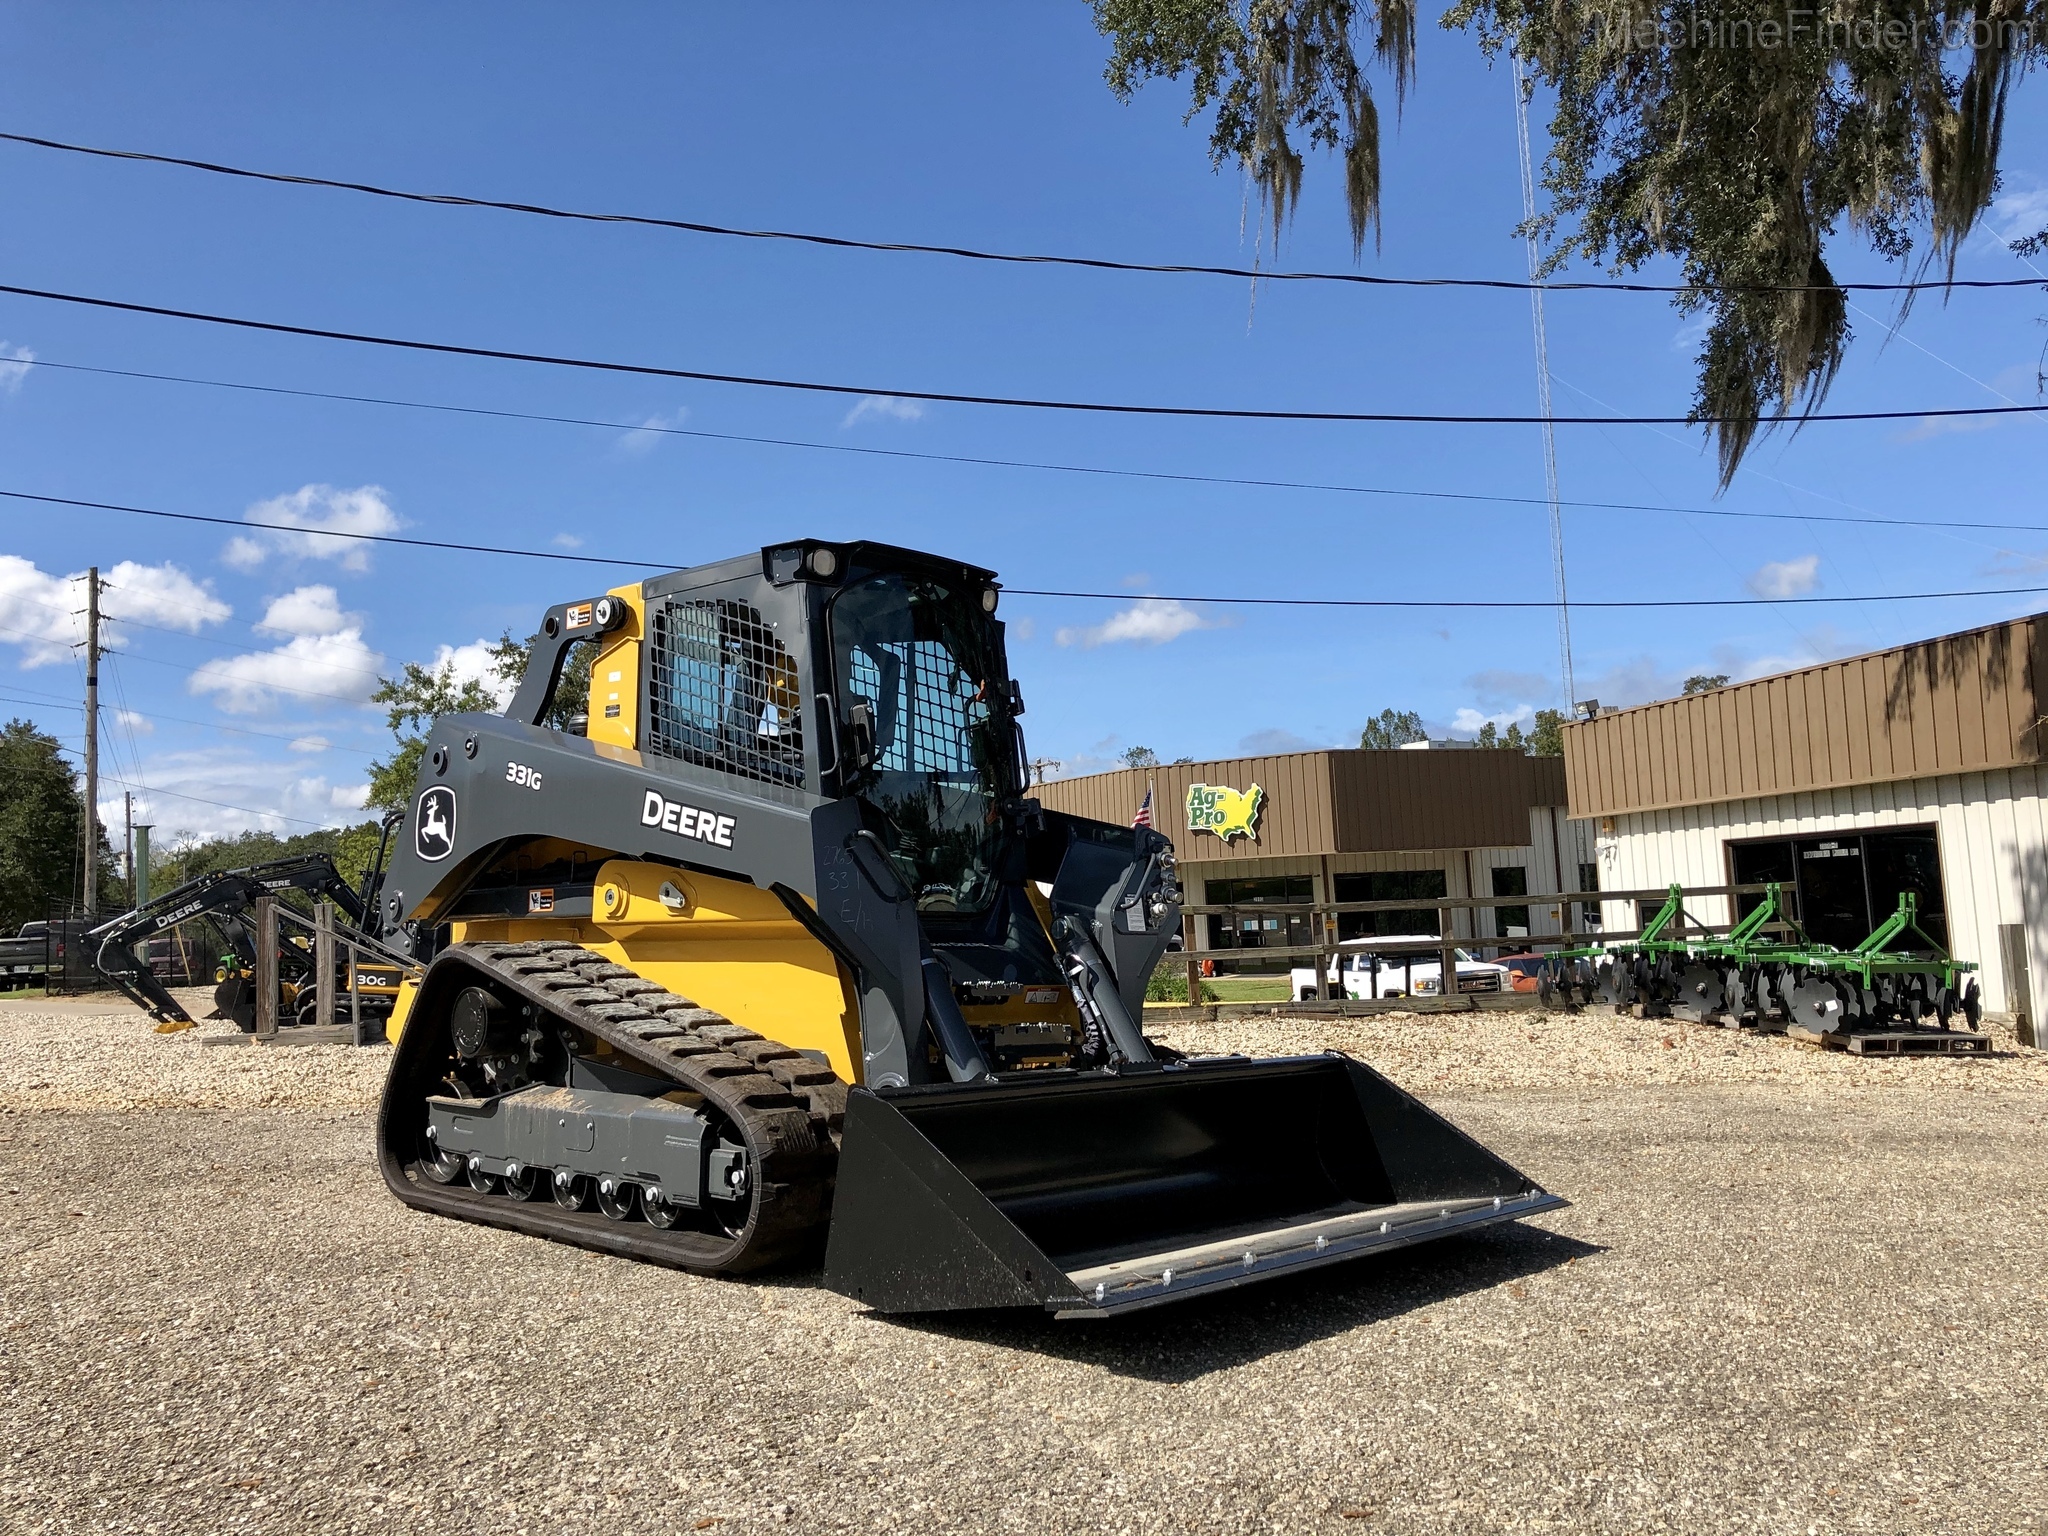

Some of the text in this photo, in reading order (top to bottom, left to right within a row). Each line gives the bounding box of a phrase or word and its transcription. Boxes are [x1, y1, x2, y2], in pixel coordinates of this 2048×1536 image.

[505, 761, 543, 791] 331G
[1189, 786, 1225, 810] Ag-
[641, 790, 736, 848] DEERE
[1190, 807, 1226, 826] Pro
[155, 899, 204, 928] DEERE
[357, 974, 387, 986] 30G
